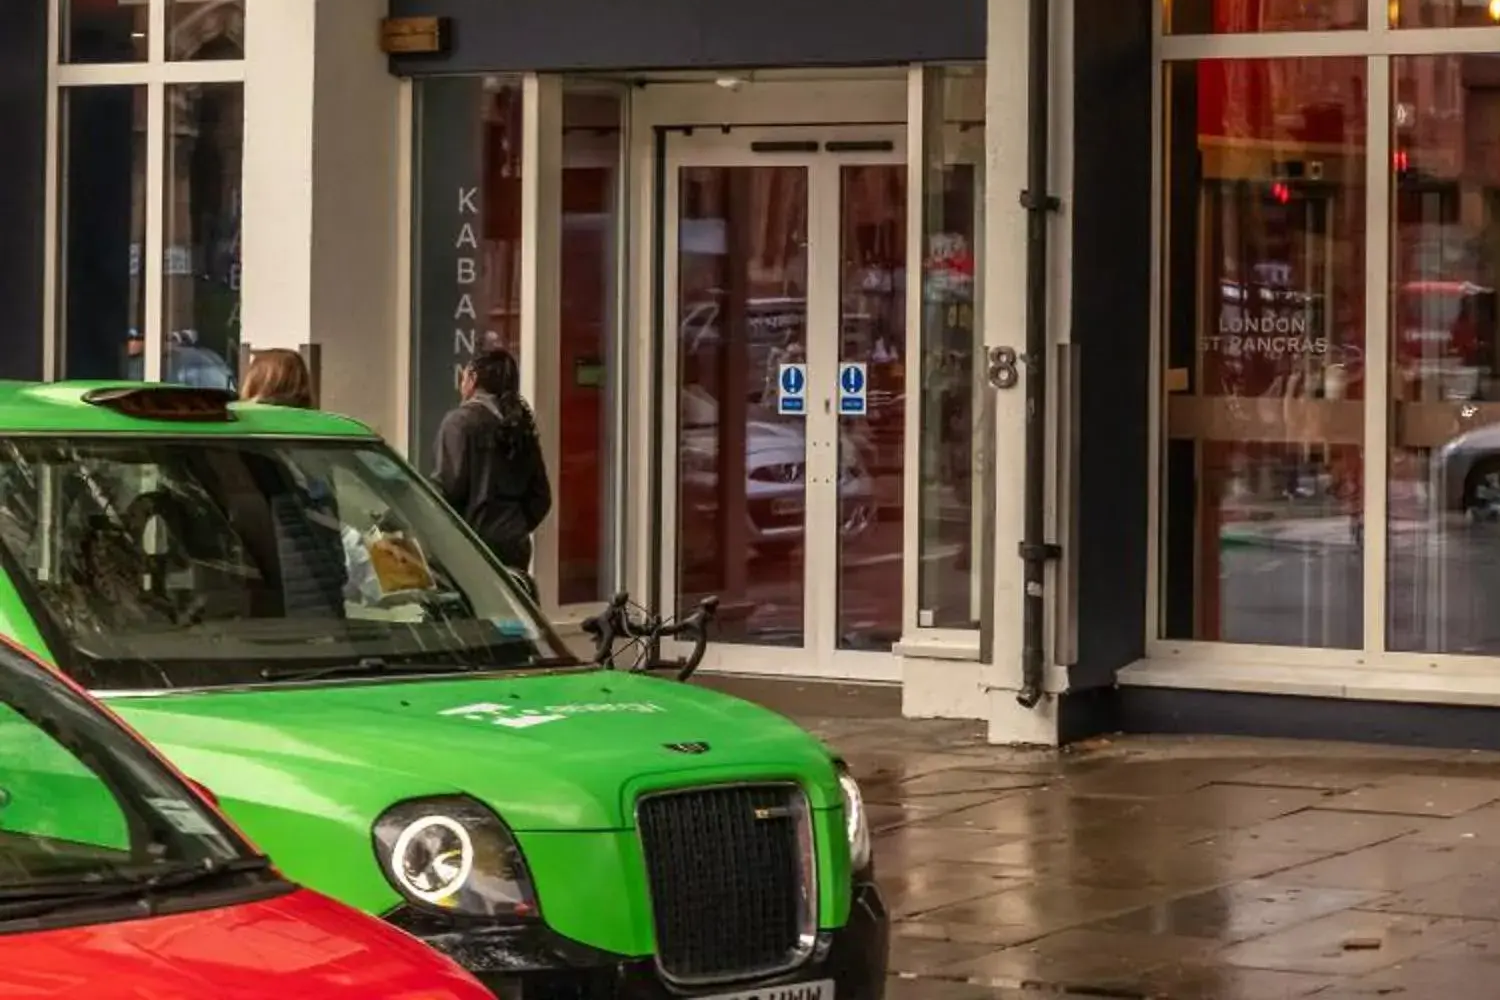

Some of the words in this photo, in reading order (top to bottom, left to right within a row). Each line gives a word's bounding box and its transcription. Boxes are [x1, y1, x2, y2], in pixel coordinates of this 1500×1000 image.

[453, 186, 479, 390] KABAN
[1219, 317, 1305, 333] LONDON
[1229, 336, 1329, 353] PANCRAS
